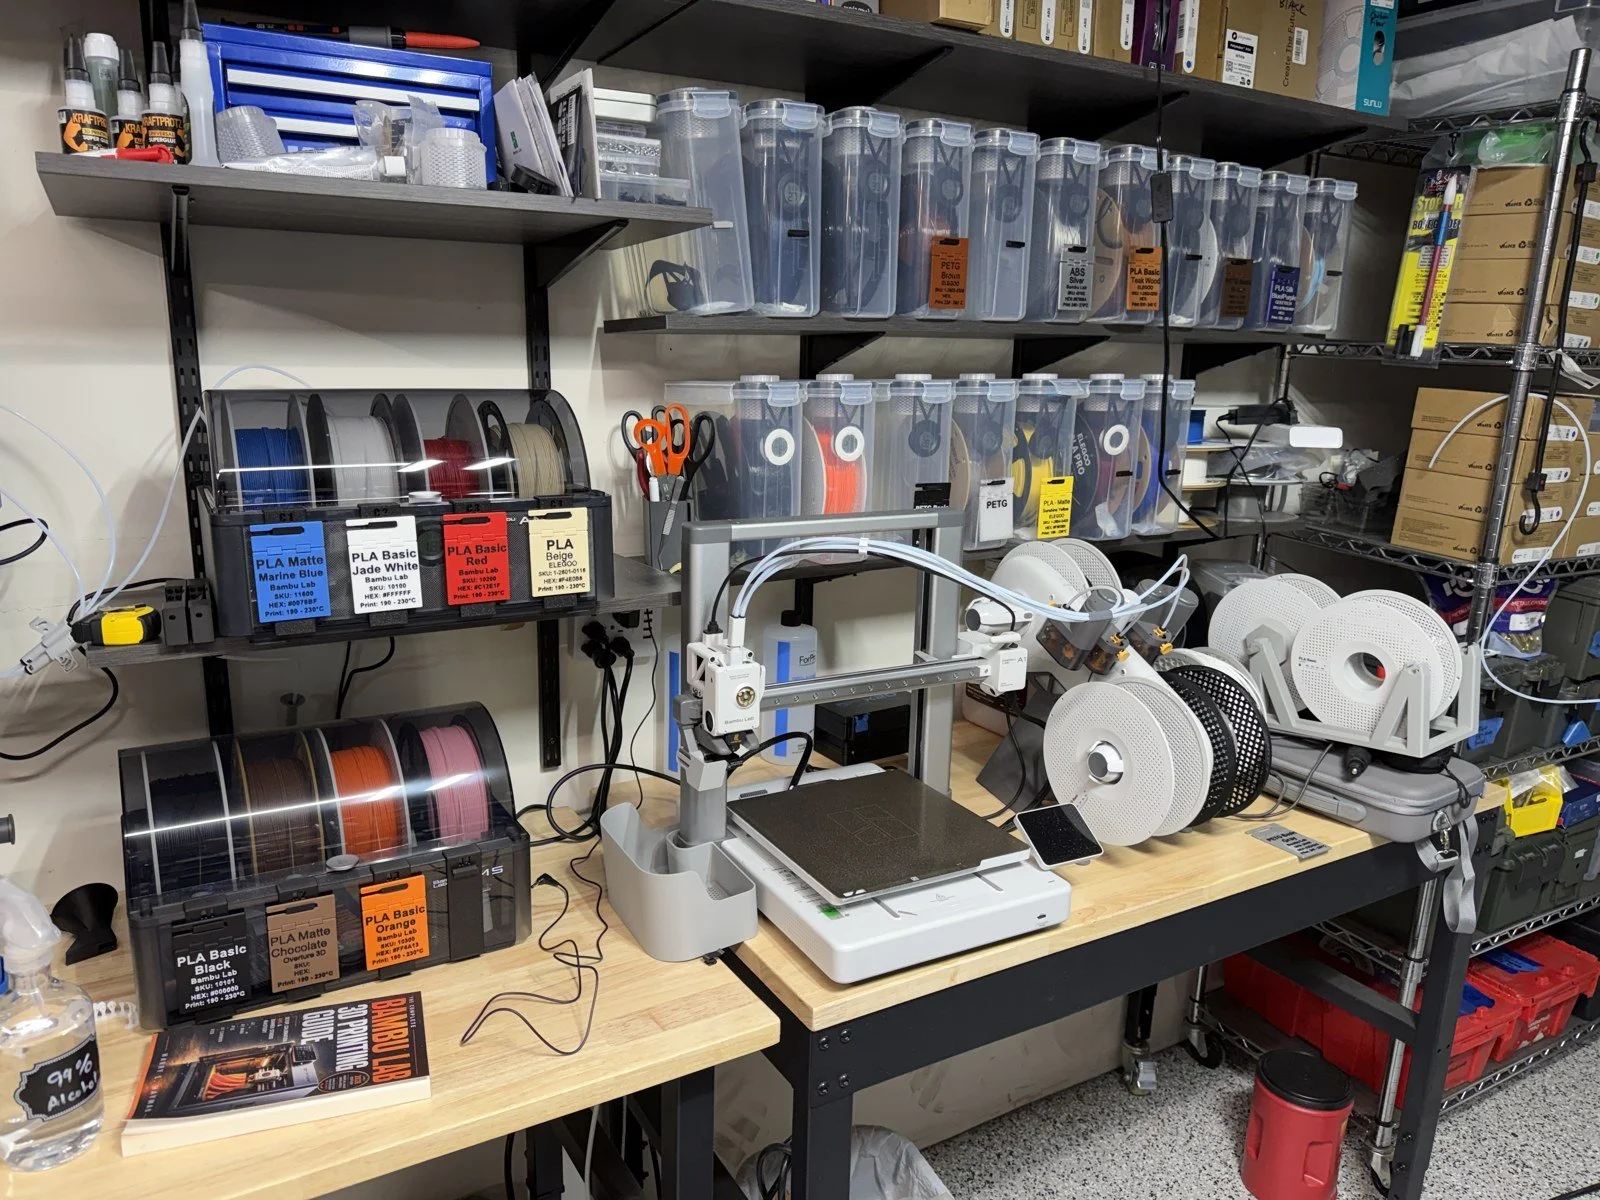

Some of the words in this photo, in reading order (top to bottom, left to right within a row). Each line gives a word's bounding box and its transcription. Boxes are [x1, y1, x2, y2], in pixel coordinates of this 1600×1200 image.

[1288, 9, 1298, 35] Futur
[1285, 36, 1294, 53] The
[1282, 62, 1292, 87] Create
[941, 261, 960, 270] PETG
[1070, 267, 1086, 277] ABS
[1129, 268, 1143, 276] PLA
[1143, 268, 1160, 276] Basic
[1077, 433, 1091, 466] ELEGOO
[1073, 454, 1086, 475] PRO
[986, 499, 1008, 509] PETG
[447, 545, 473, 557] PLA
[475, 543, 507, 555] Basic
[546, 538, 574, 551] PLA
[352, 551, 379, 563] PLA
[382, 548, 417, 560] Basic
[466, 556, 488, 566] Red
[546, 551, 573, 562] Beige
[256, 559, 285, 570] PLA
[288, 556, 324, 567] Matte
[352, 565, 381, 576] Jade
[384, 561, 419, 573] White
[548, 560, 577, 569] ELEGOO
[258, 572, 296, 582] Marine
[299, 569, 324, 579] Blue
[365, 575, 392, 584] Bambu
[394, 573, 409, 581] Lab
[458, 569, 485, 577] Bambu
[270, 583, 299, 592] Bambu
[301, 581, 316, 589] Lab
[369, 584, 386, 592] SKU:
[274, 592, 292, 600] SKU:
[268, 601, 286, 609] HEX:
[360, 601, 379, 609] Print:
[265, 610, 284, 618] Print:
[724, 717, 743, 725] Bambu
[365, 913, 390, 926] PLA
[393, 905, 425, 919] Basic
[376, 919, 416, 933] Orange
[270, 934, 296, 947] PLA
[298, 928, 331, 940] Matte
[377, 932, 402, 942] Bambu
[404, 928, 417, 936] Lab
[271, 940, 327, 958] Chocolate
[380, 941, 396, 949] SKU:
[177, 953, 206, 967] PLA
[209, 945, 247, 960] Basic
[283, 952, 315, 963] Overture
[316, 949, 326, 957] 3D
[376, 949, 392, 957] HEX:
[195, 960, 231, 975] Black
[372, 957, 389, 965] Print:
[191, 973, 220, 985] Bambu
[222, 969, 238, 978] Lab
[194, 984, 213, 992] SKU:
[215, 978, 235, 987] 10101
[191, 993, 209, 1001] HEX:
[210, 985, 239, 995] #000000
[185, 1001, 205, 1009] Print:
[337, 1004, 368, 1020] 3D
[300, 1009, 336, 1045] GUIDE
[371, 998, 410, 1053] BAMBU
[335, 1018, 369, 1072] PRINTING
[372, 1053, 412, 1083] LAB
[47, 1070, 98, 1112] Alcohol
